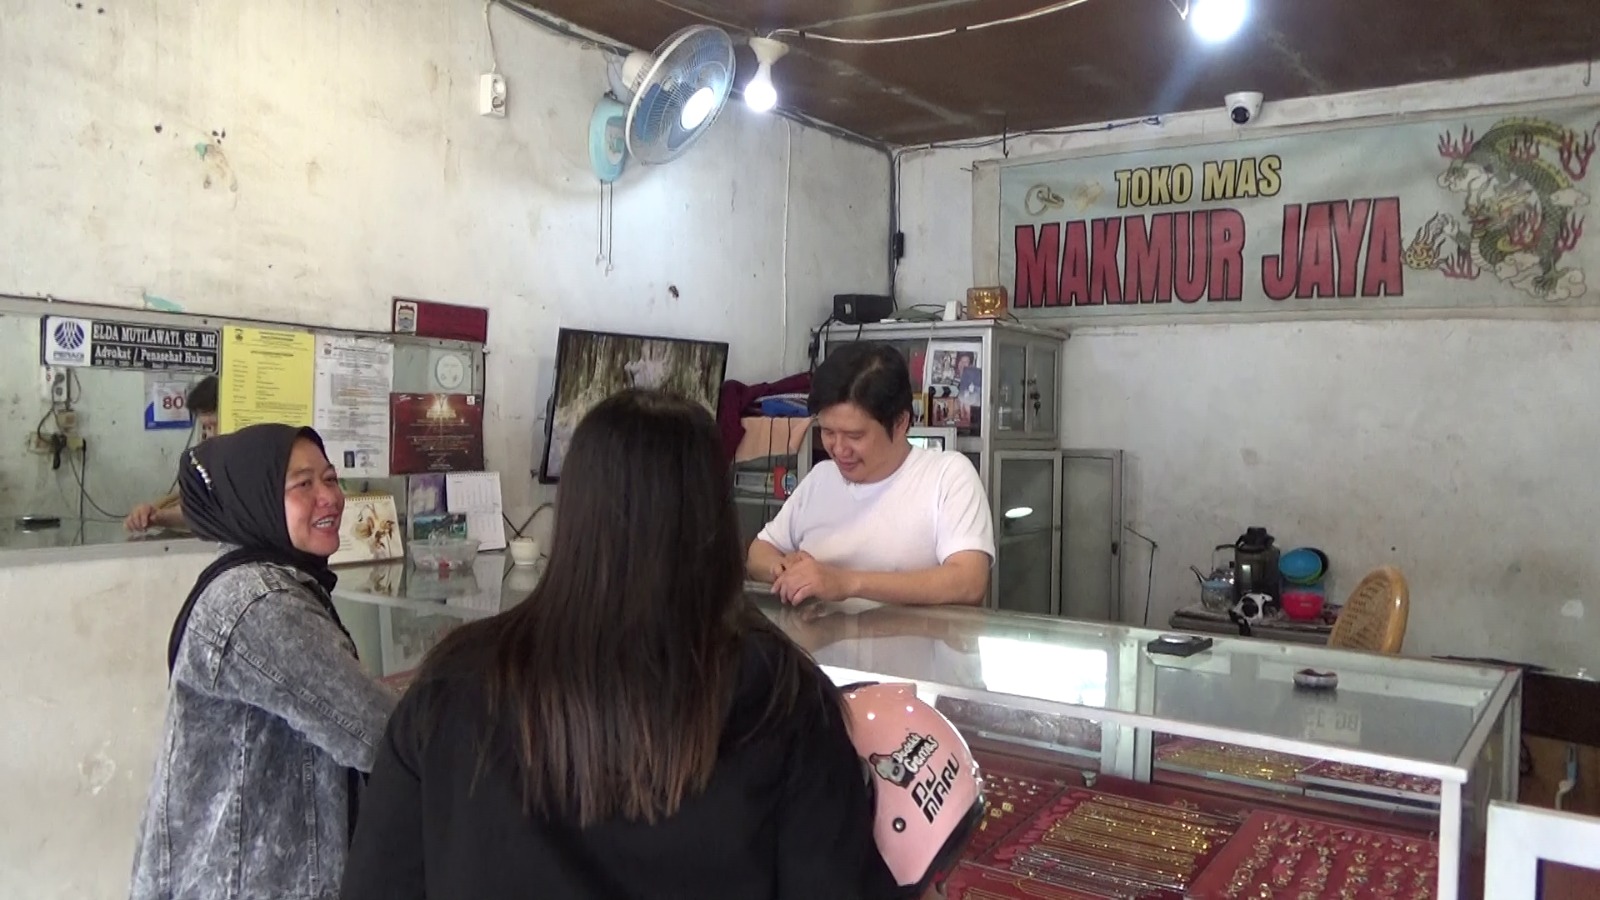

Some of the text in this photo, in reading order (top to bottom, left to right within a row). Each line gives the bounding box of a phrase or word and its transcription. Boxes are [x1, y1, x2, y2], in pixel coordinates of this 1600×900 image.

[1114, 155, 1282, 208] TOKO MAS
[1014, 197, 1404, 308] MAKMUR JAYA
[93, 324, 119, 340] ELDA
[121, 326, 182, 348] MUTILAWATI,
[184, 332, 199, 347] SH.
[95, 344, 131, 359] Advokat
[184, 351, 214, 365] Hukum
[911, 764, 937, 808] DJ
[923, 752, 960, 824] MARU
